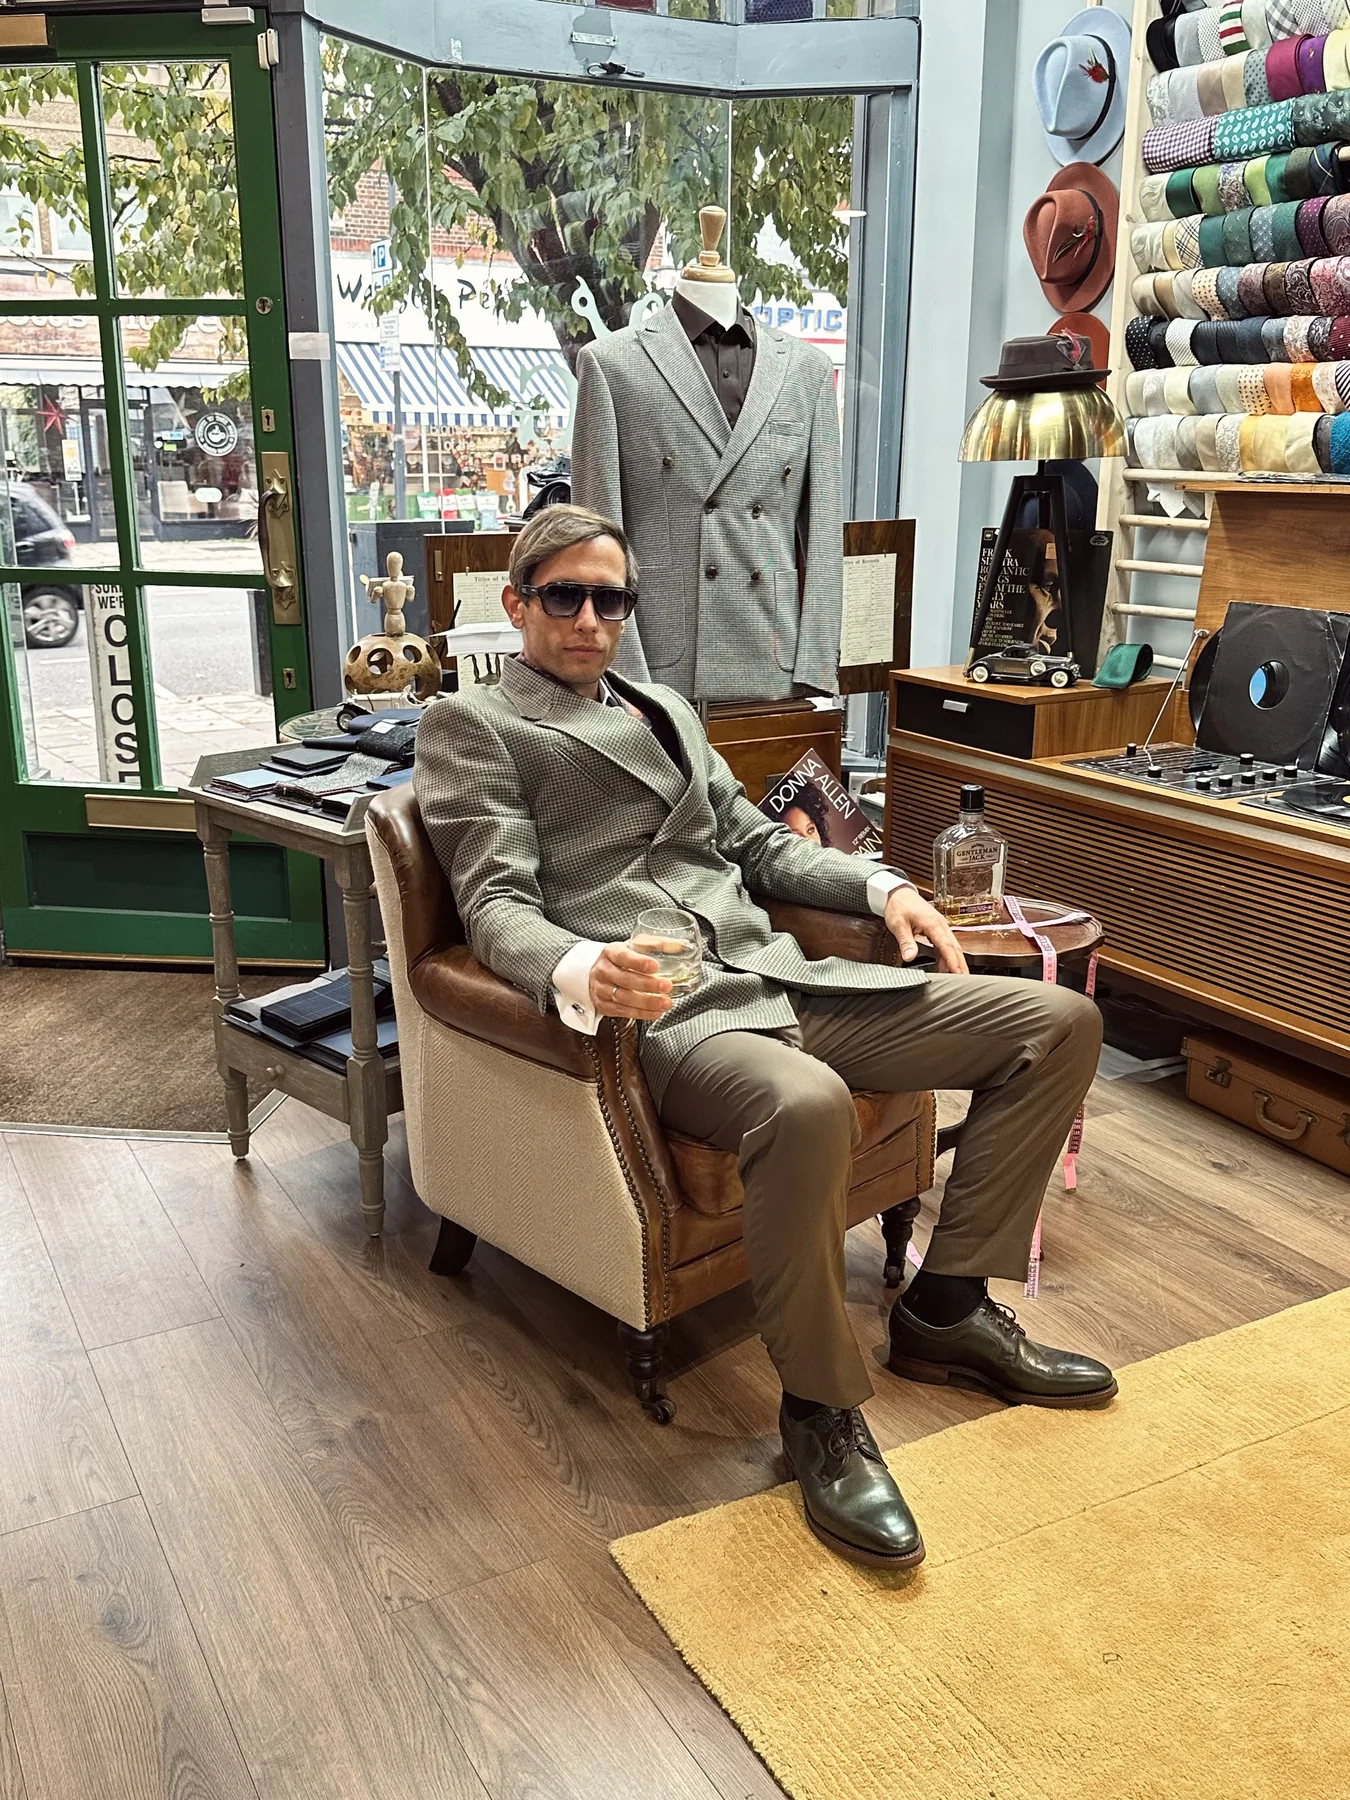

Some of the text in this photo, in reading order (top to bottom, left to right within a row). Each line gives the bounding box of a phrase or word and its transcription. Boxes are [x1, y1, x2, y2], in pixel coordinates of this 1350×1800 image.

[982, 548, 1012, 557] FRK
[981, 557, 1018, 566] SITRA
[980, 566, 1029, 576] RANTIC
[979, 575, 1009, 583] SGS
[978, 583, 1004, 592] FM
[977, 591, 1006, 600] ELY
[97, 596, 124, 609] WE'R
[976, 600, 1004, 609] YRS
[104, 614, 141, 783] CLOS
[769, 758, 822, 813] DONNA
[814, 773, 856, 820] ALLEN
[956, 847, 998, 857] GENTLEMAN
[969, 854, 986, 862] JACK
